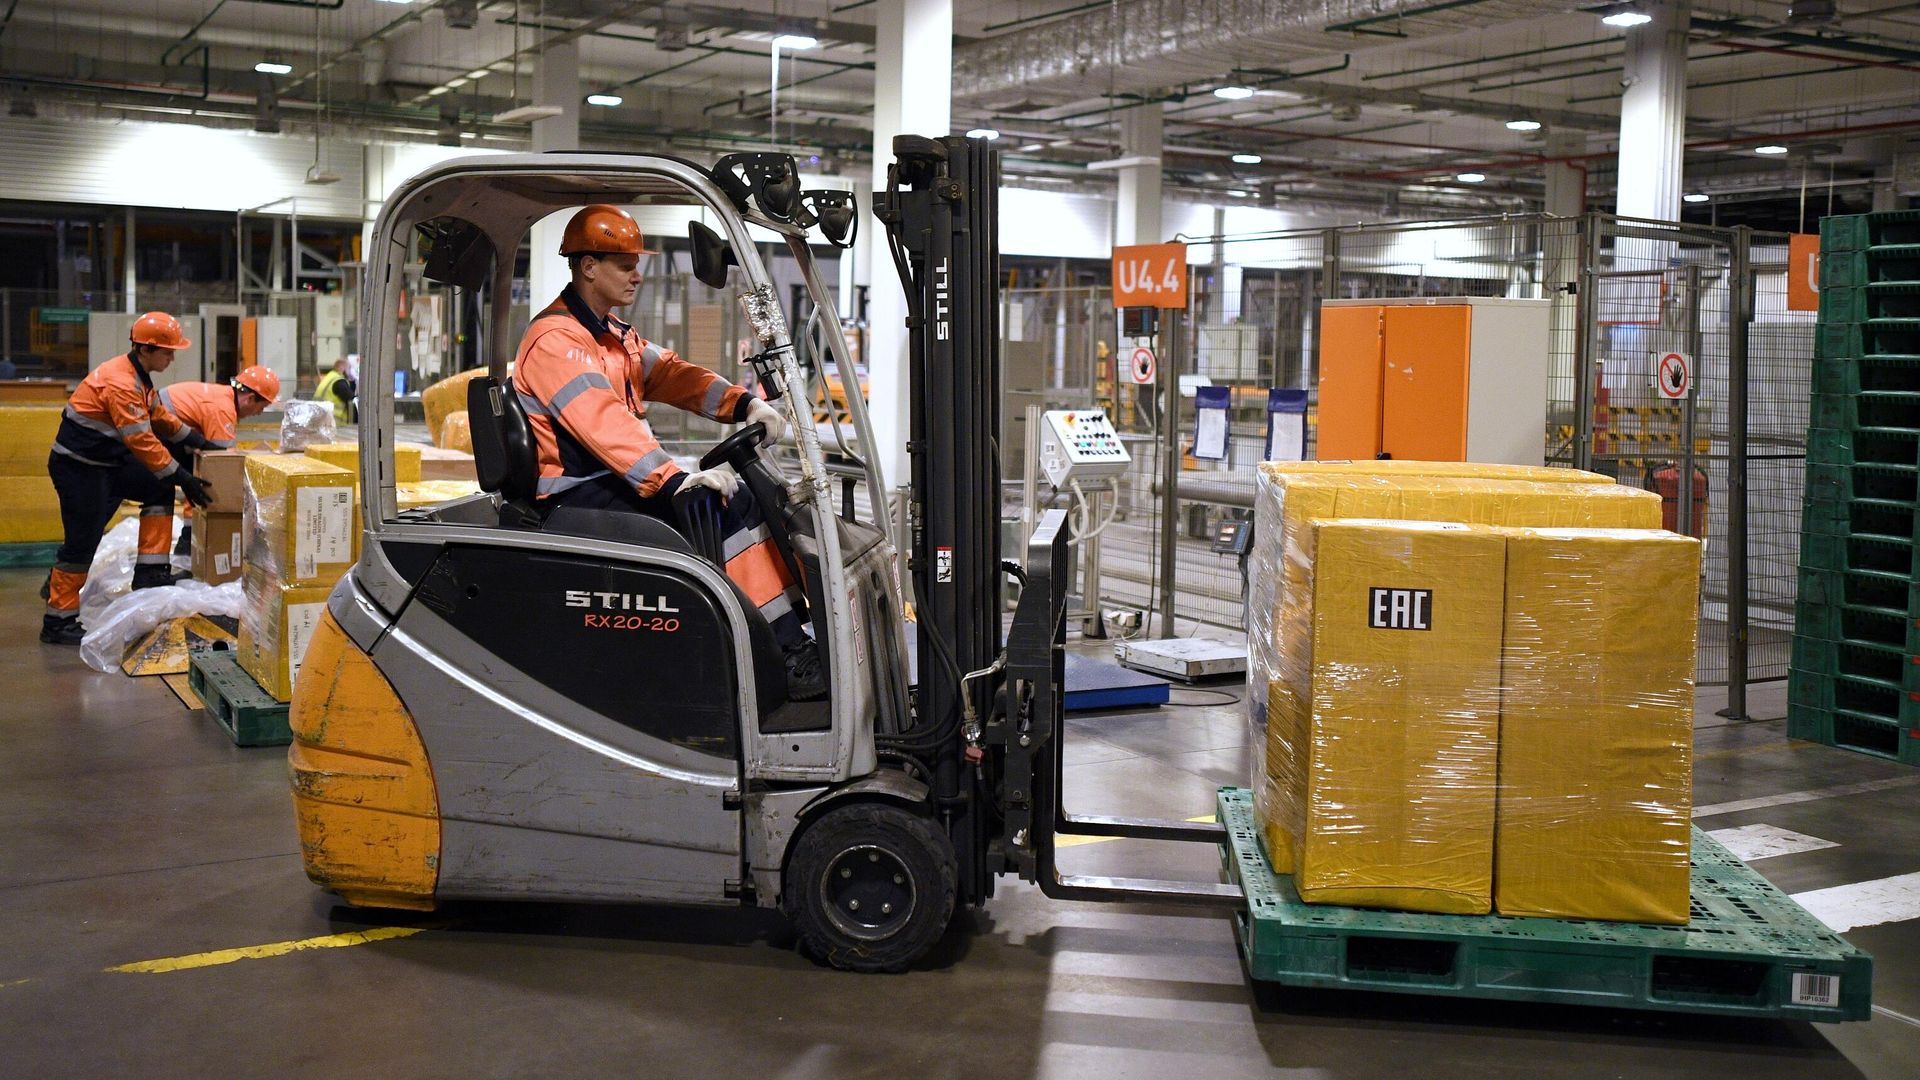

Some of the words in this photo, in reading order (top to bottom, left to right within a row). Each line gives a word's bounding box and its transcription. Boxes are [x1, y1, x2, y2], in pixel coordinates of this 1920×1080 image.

[1119, 258, 1179, 293] U4.4
[936, 257, 949, 341] STILL
[565, 590, 680, 613] STILL
[1374, 589, 1427, 629] EAC
[584, 614, 680, 632] RX20-20
